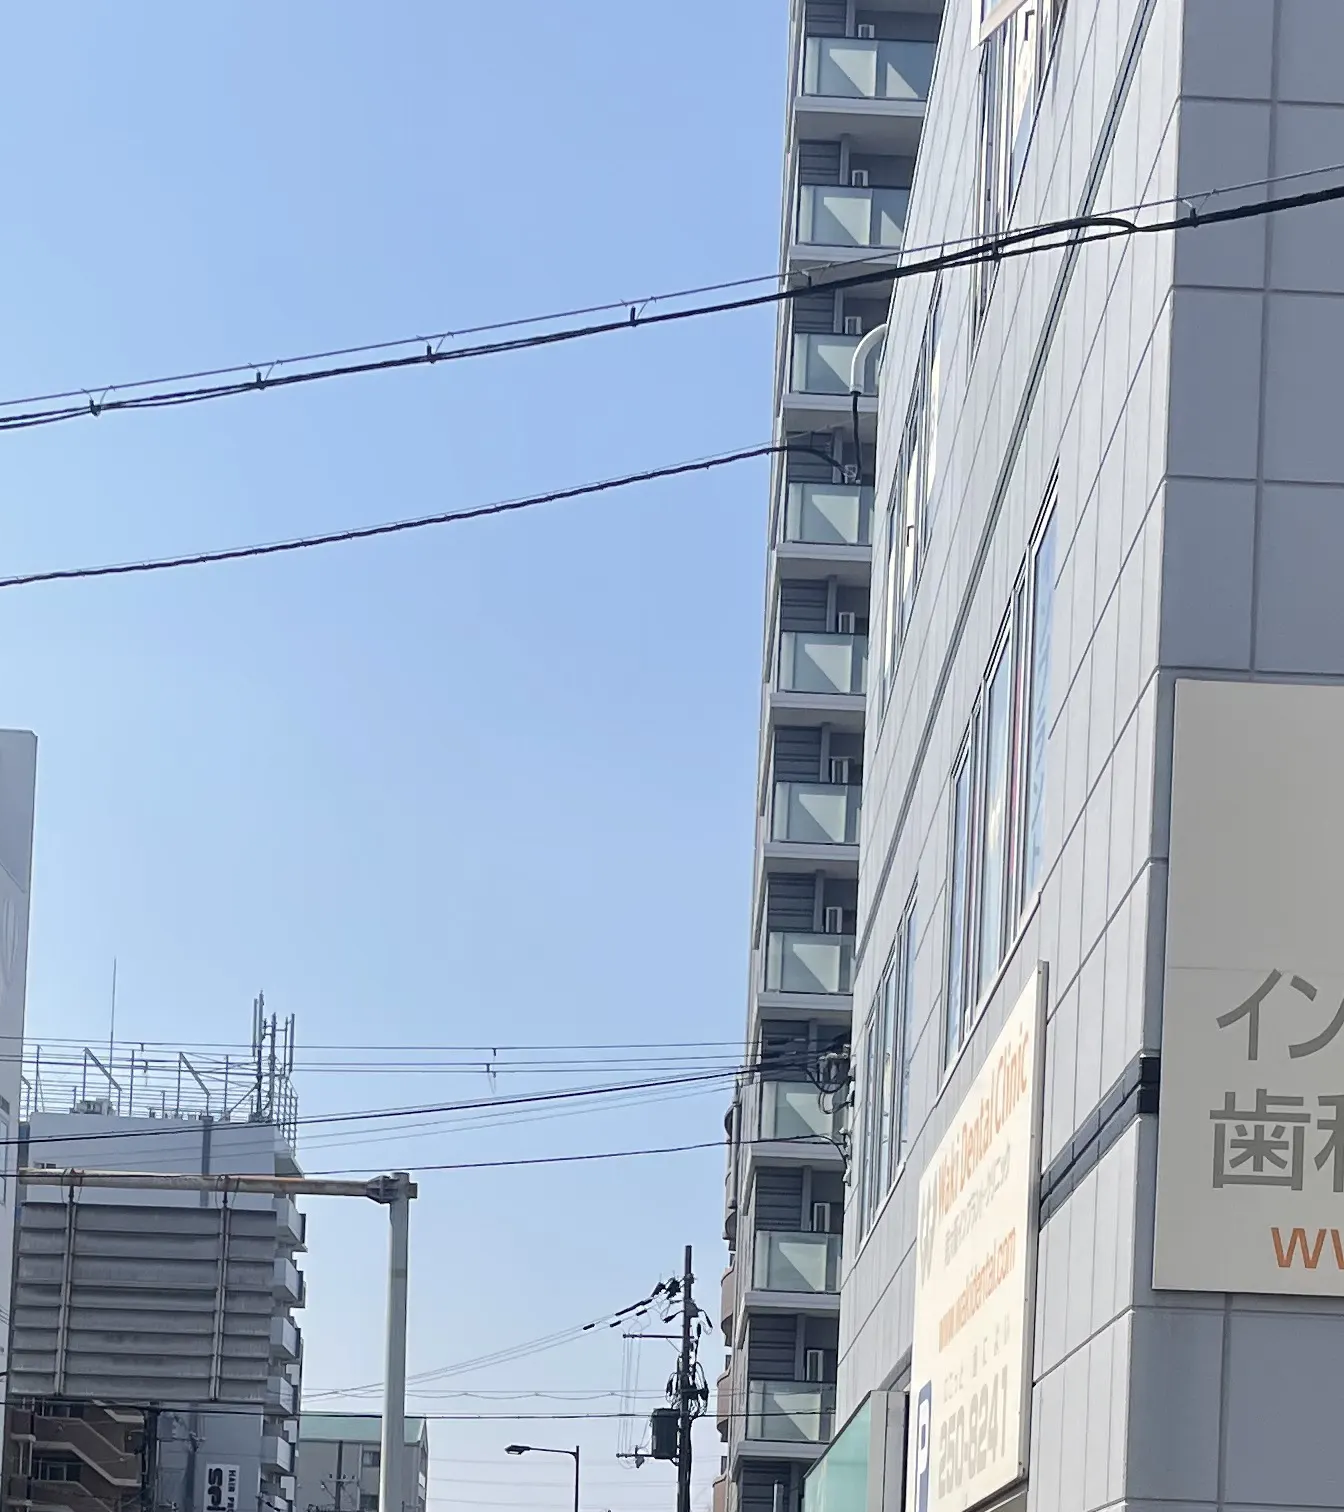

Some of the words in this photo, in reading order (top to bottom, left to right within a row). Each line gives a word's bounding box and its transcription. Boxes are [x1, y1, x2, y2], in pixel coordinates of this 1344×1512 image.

[937, 1130, 960, 1217] Waki
[960, 1067, 995, 1192] Dental
[994, 1022, 1029, 1134] Clinic
[916, 1398, 929, 1512] P
[938, 1364, 1008, 1500] 250-8241
